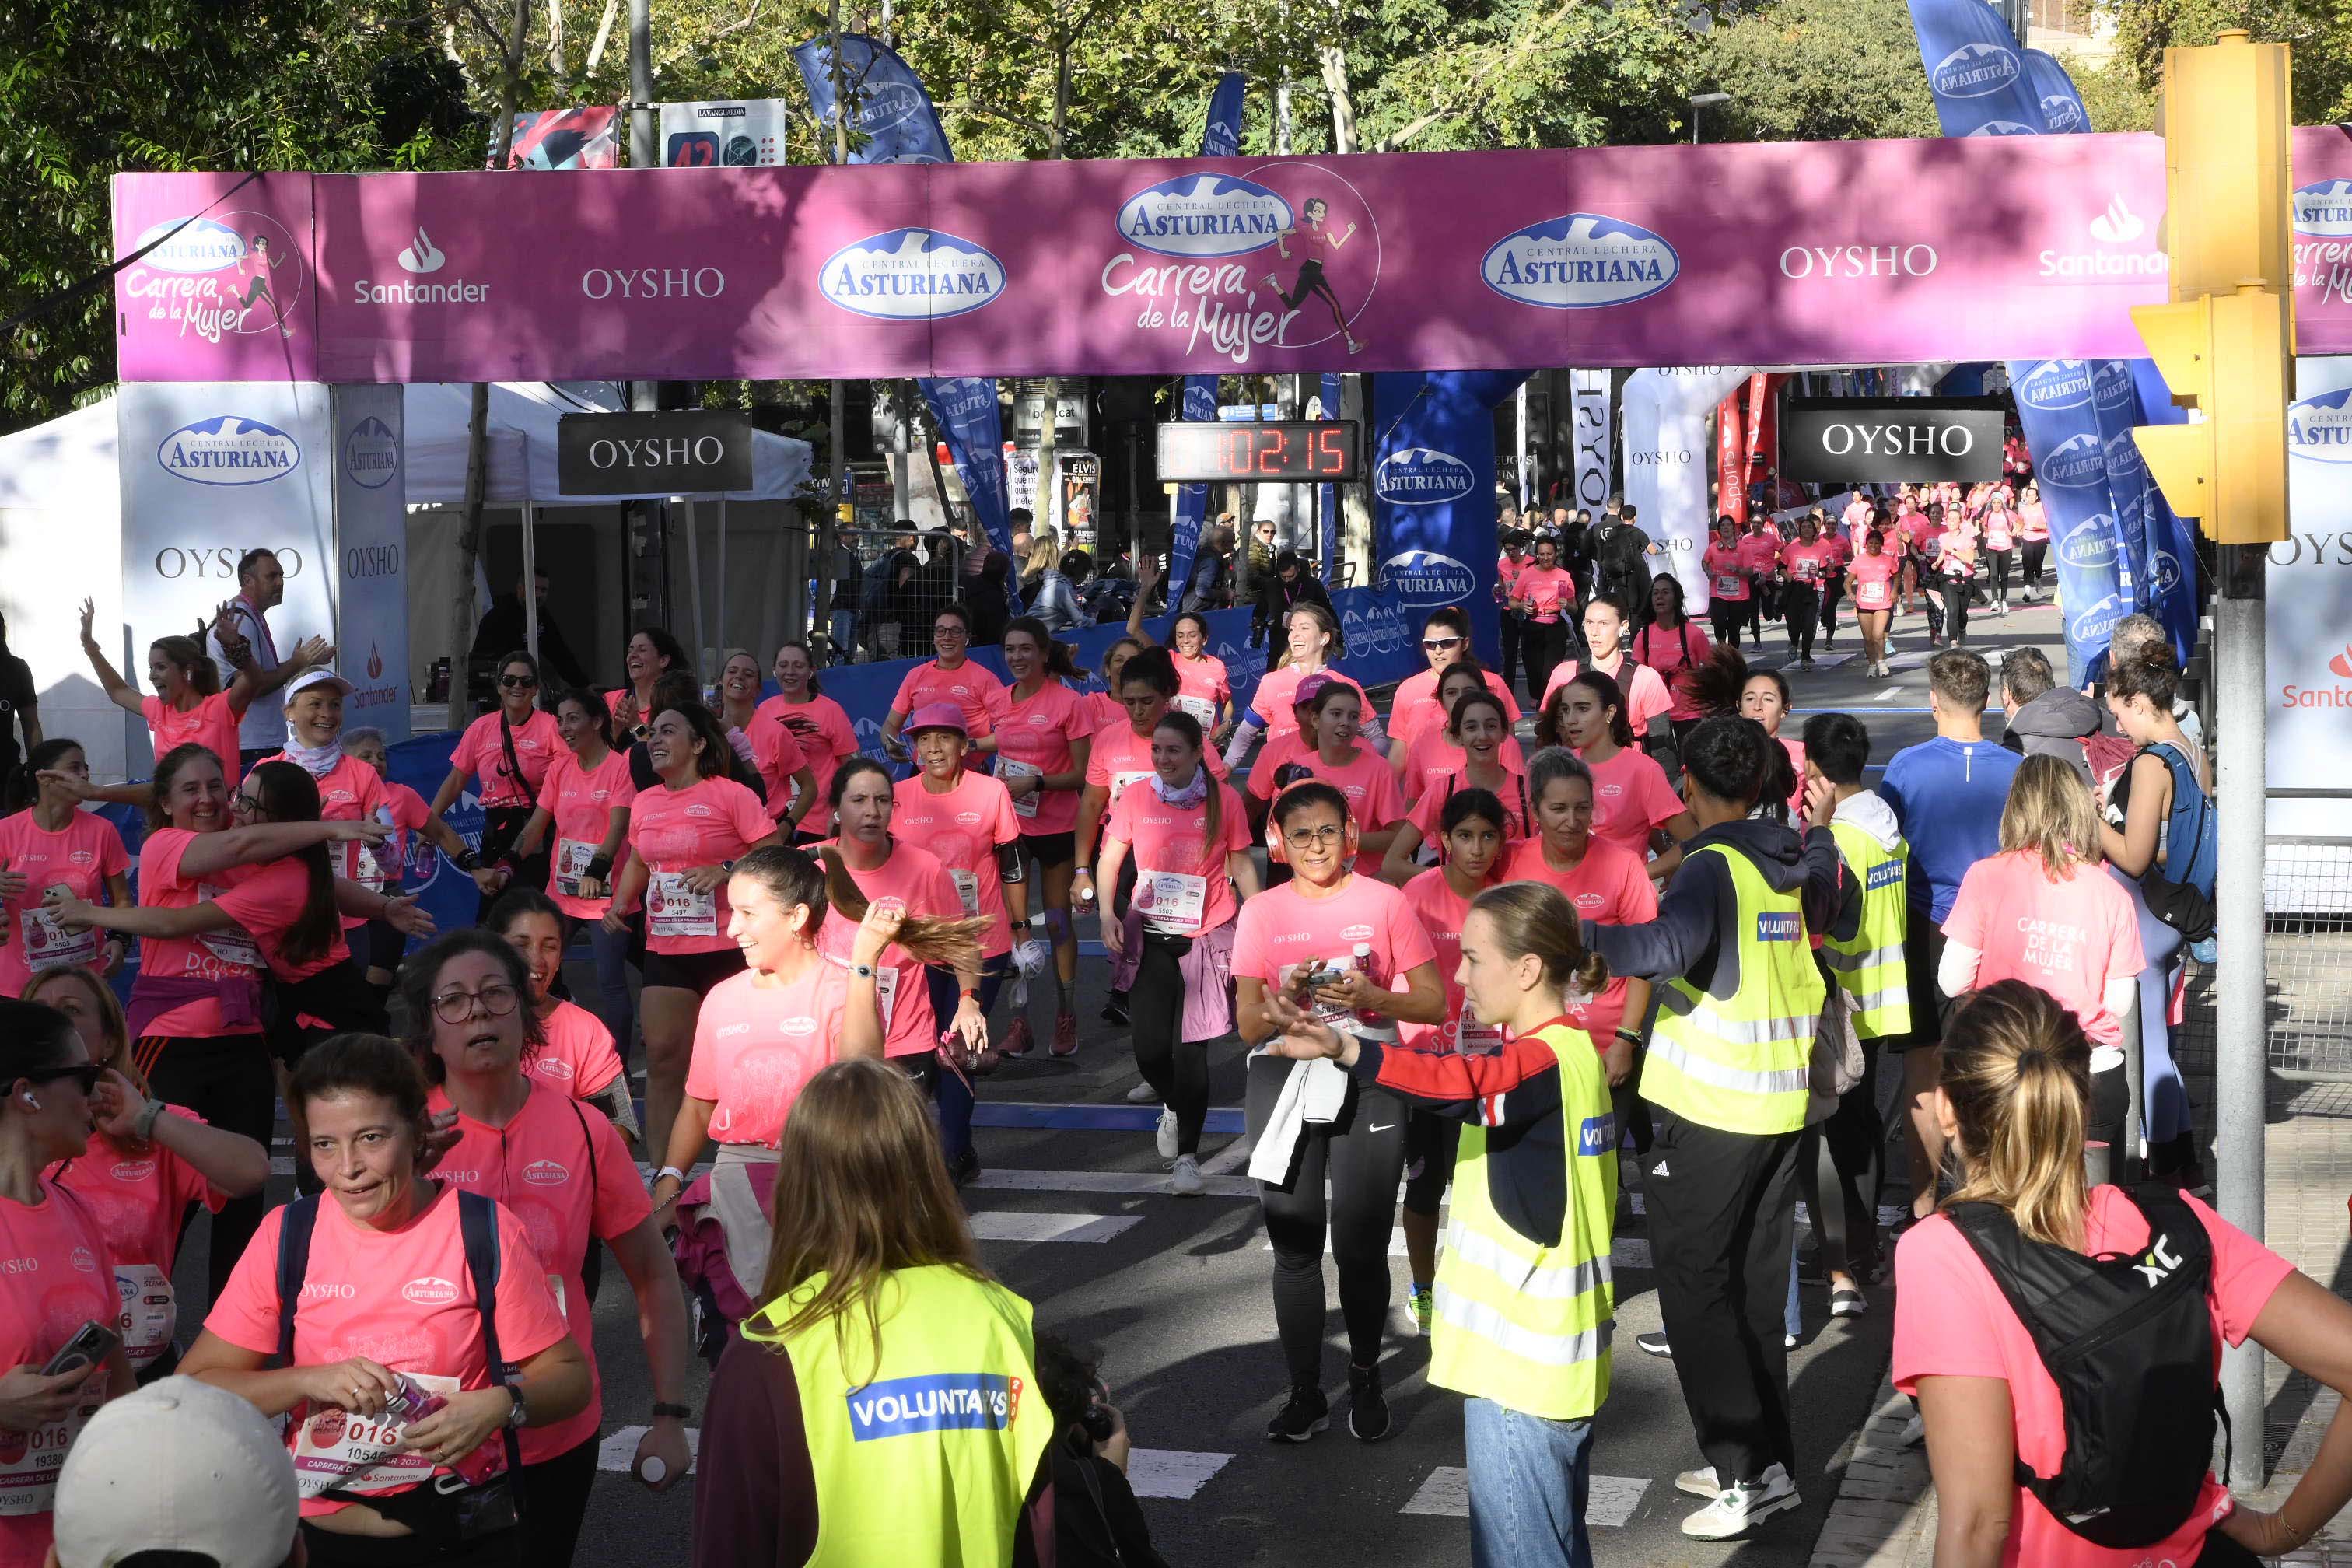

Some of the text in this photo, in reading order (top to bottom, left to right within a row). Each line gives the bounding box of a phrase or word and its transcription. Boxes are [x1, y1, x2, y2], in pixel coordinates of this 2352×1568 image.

[1157, 201, 1275, 212] CENTRAL LECHERA
[1130, 205, 1279, 237] ASTURIANA
[1526, 244, 1657, 257] CENTRAL LECHERA
[1780, 244, 1937, 278] OYSHO
[863, 259, 985, 269] CENTRAL LECHERA
[1496, 250, 1664, 285] ASTURIANA
[2039, 250, 2168, 275] Santand
[126, 270, 218, 298] Carrera
[582, 267, 725, 299] OYSHO
[835, 268, 991, 296] ASTURIANA
[1101, 253, 1246, 297] Carrera
[2312, 266, 2325, 285] la
[355, 279, 490, 303] Santander
[149, 295, 253, 343] de la Mujer
[1137, 289, 1300, 364] de la Mujer
[1822, 424, 1973, 457] OYSHO
[169, 442, 290, 467] ASTURIANA
[590, 436, 723, 468] OYSHO
[1633, 450, 1692, 466] OYSHO
[1073, 464, 1096, 473] ELVIS
[1379, 471, 1467, 492] ASTURIANA
[156, 548, 303, 579] OYSO
[347, 544, 398, 579] OYSHO
[354, 685, 397, 709] Santander
[667, 898, 690, 907] 016
[1156, 896, 1179, 907] 016
[49, 931, 65, 941] 01
[1275, 933, 1311, 944] OYSHO
[2017, 917, 2087, 943] CARRERA
[2028, 933, 2070, 954] DE LA
[2023, 948, 2073, 971] MUJER
[525, 1169, 566, 1180] ASTURIANA
[1652, 1169, 1670, 1178] adidas
[0, 1257, 37, 1275] YSHO
[408, 1285, 456, 1298] ASTURIANA
[31, 1428, 68, 1448] 016
[350, 1422, 397, 1445] 016
[35, 1454, 63, 1468] 19380
[308, 1461, 345, 1472] CARRERA
[299, 1479, 330, 1490] OYSH
[373, 1474, 418, 1482] Santander
